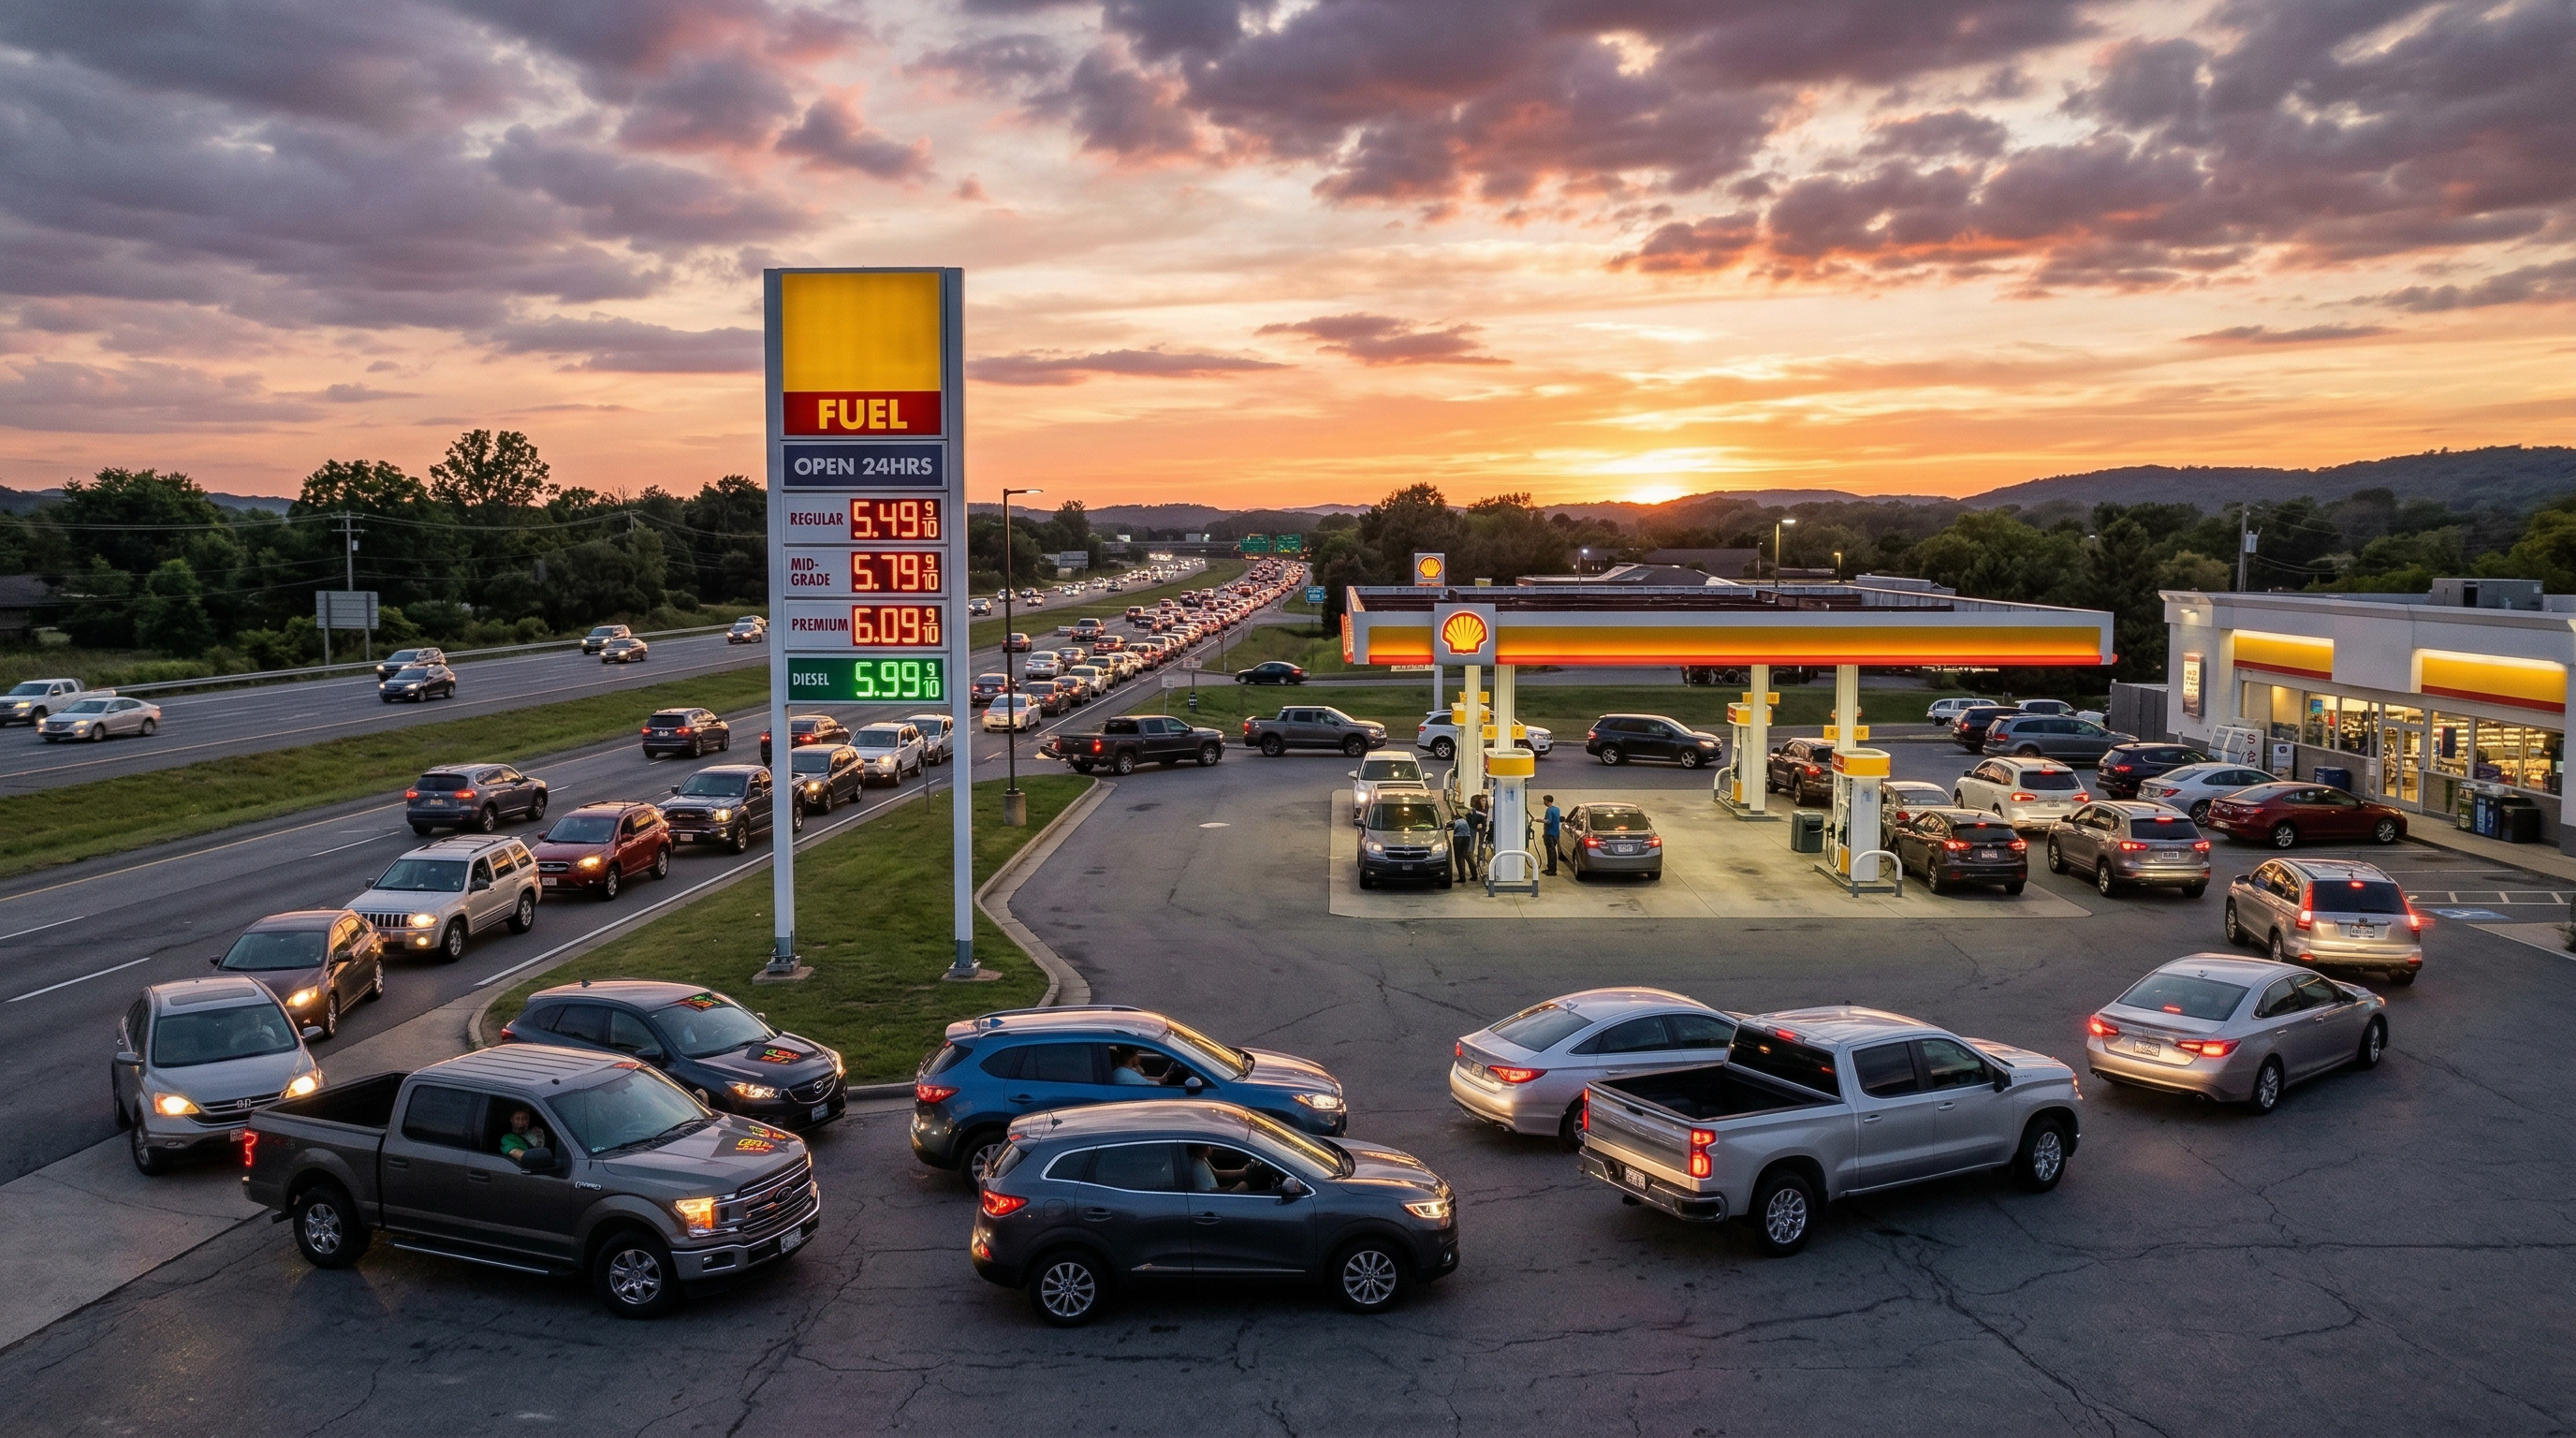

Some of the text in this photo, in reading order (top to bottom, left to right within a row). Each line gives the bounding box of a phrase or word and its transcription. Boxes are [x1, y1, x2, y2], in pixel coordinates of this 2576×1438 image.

[819, 399, 907, 430] FUEL
[795, 458, 932, 475] OPEN 24HRS
[790, 512, 843, 525] REGULAR
[854, 502, 918, 537] 5.49
[791, 558, 819, 571] MID-
[854, 554, 918, 590] 5.79
[791, 573, 830, 586] GRADE
[792, 619, 848, 631] PREMIUM
[855, 608, 919, 643] 6.09
[793, 673, 829, 685] DIESEL
[856, 662, 919, 697] 5.99
